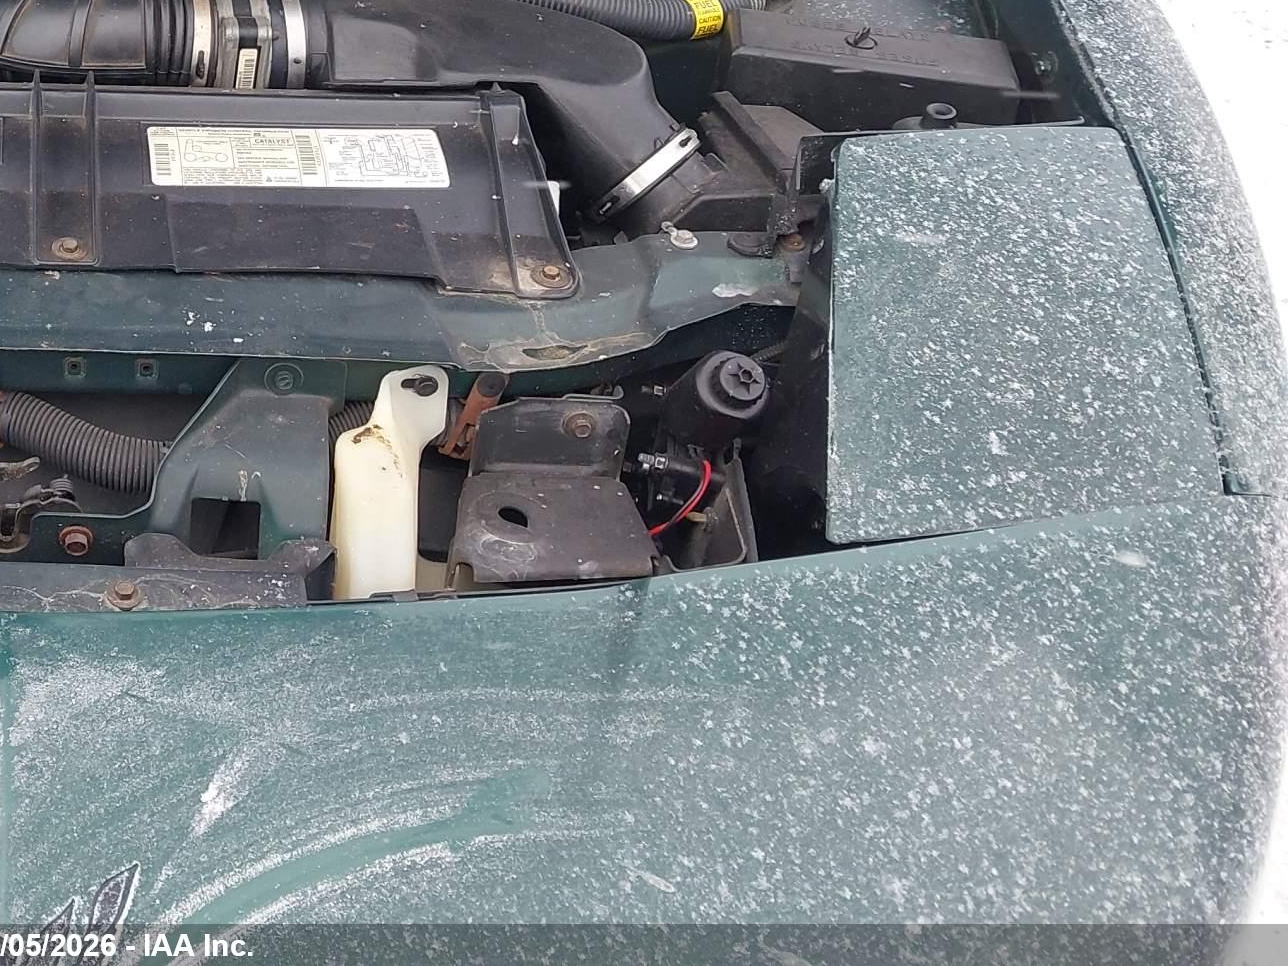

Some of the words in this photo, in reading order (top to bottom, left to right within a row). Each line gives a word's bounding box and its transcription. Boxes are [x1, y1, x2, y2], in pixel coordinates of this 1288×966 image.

[694, 0, 718, 10] FUEL
[699, 15, 722, 24] CAUTION
[697, 24, 719, 34] FUEL
